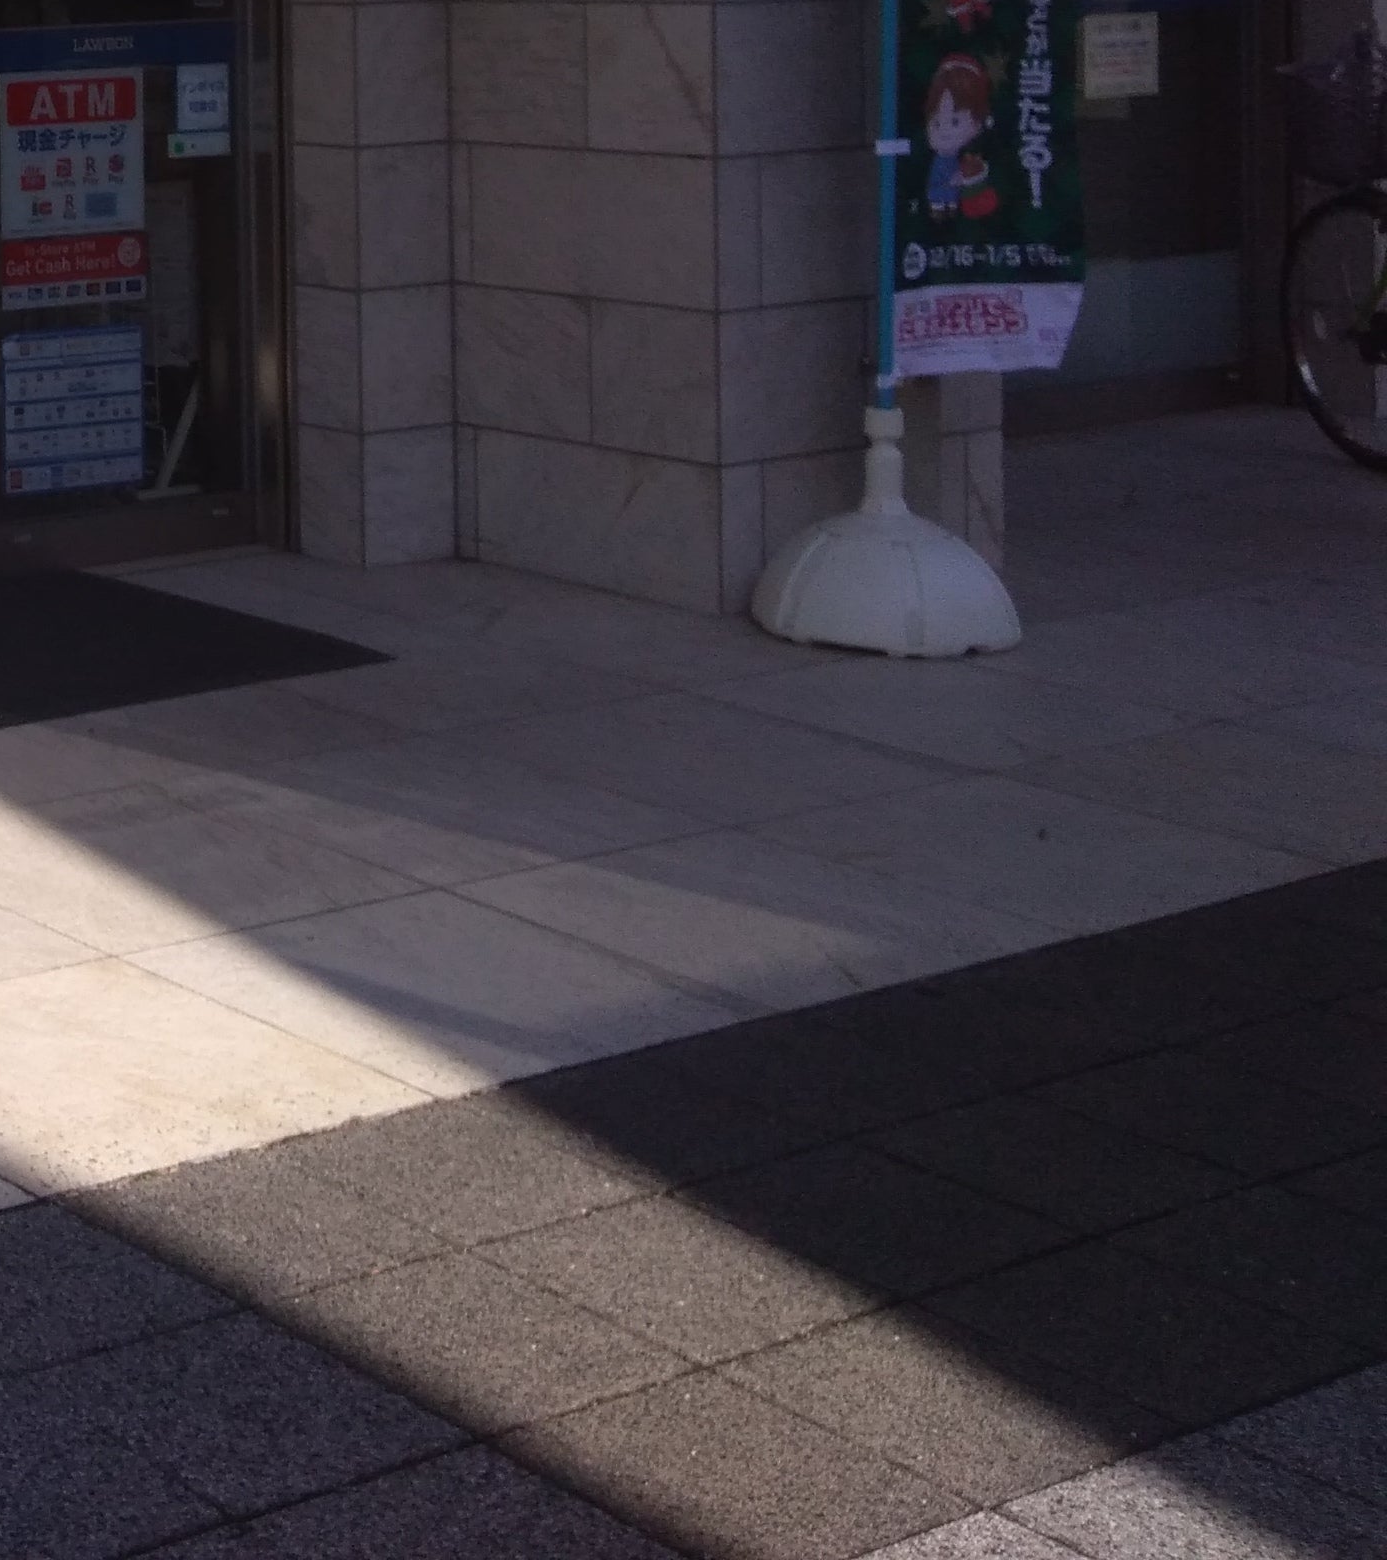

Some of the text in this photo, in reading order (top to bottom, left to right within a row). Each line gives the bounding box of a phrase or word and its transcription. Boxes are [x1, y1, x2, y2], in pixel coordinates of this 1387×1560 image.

[72, 35, 135, 52] LAWSON
[29, 80, 116, 122] ATM
[5, 260, 32, 278] Get
[35, 256, 72, 275] Cash
